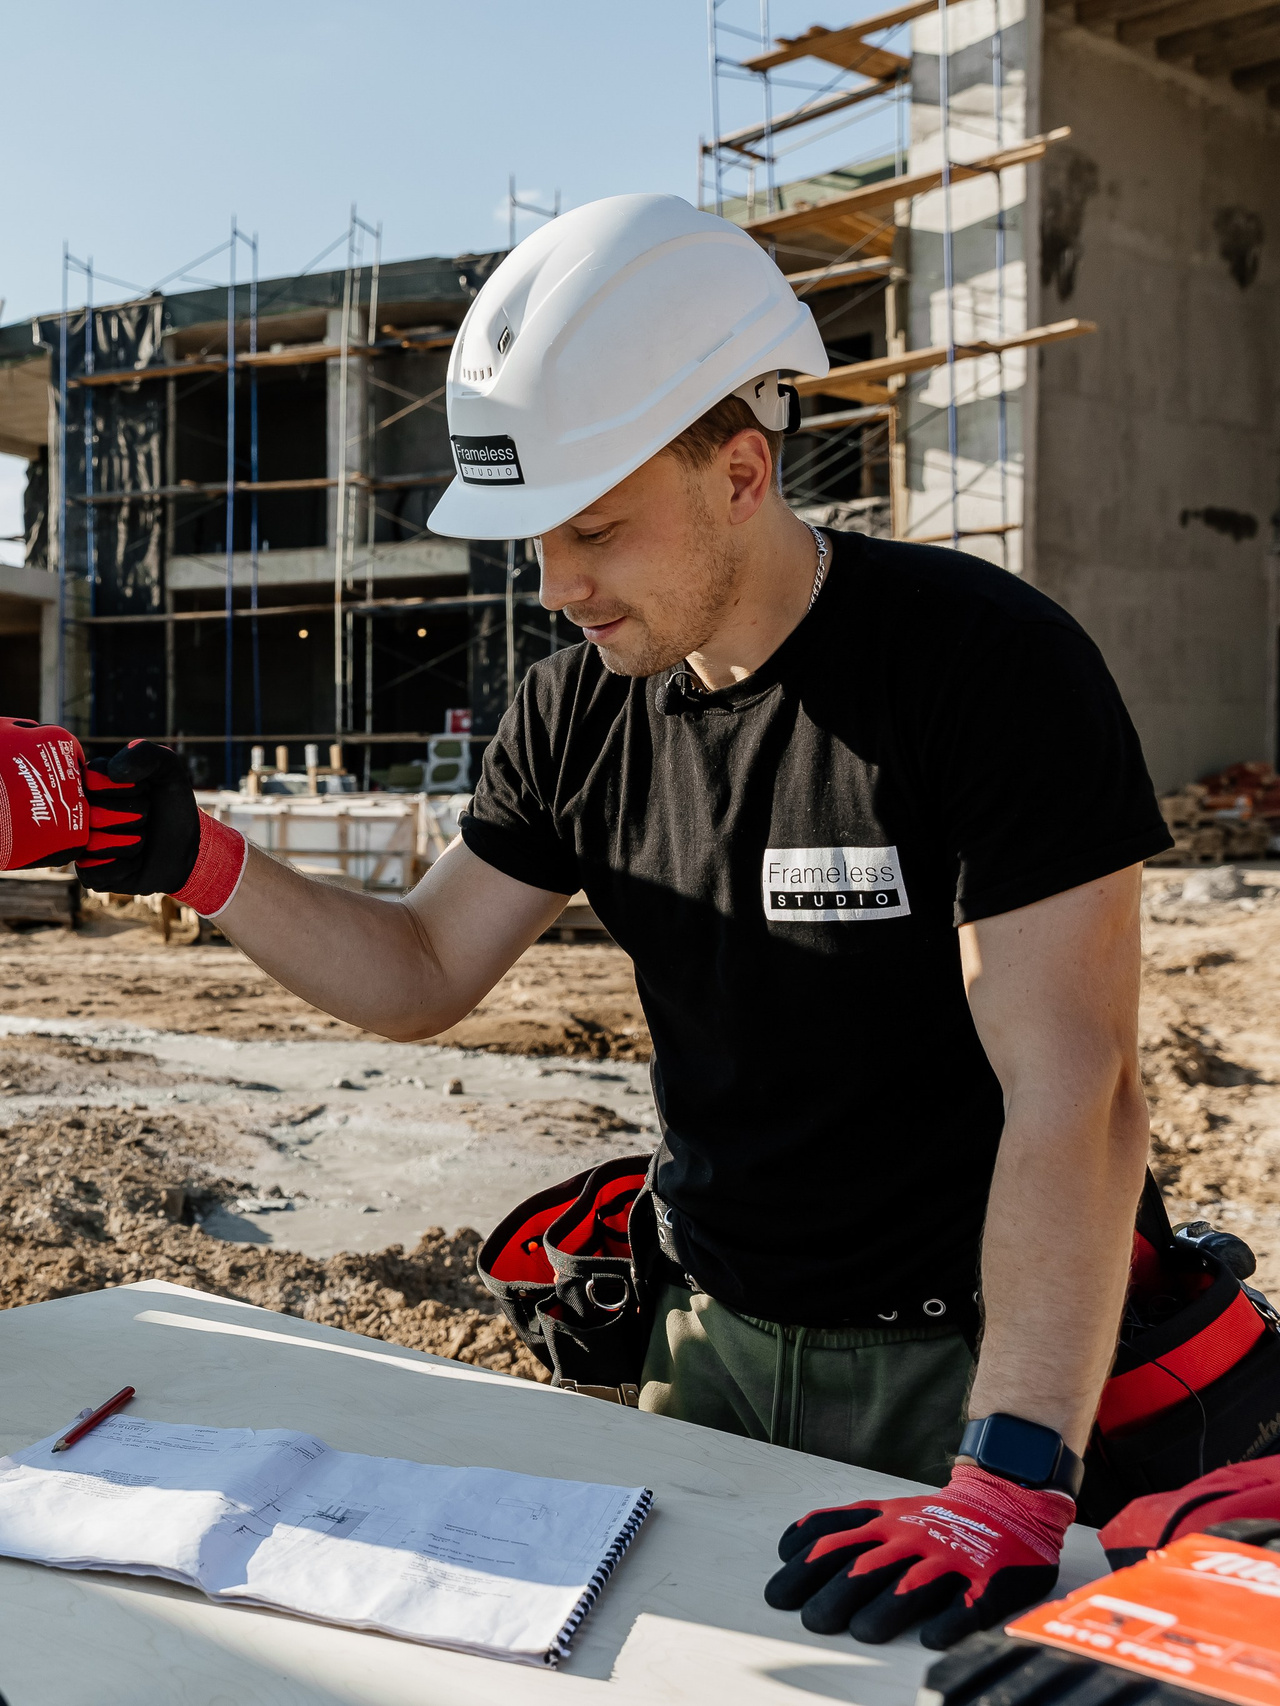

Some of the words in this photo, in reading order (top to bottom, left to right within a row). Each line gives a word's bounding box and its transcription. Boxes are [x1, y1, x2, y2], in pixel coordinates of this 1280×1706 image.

[456, 444, 515, 461] Frameless
[464, 467, 513, 477] STUDIO
[769, 861, 895, 884] Frameless
[778, 893, 889, 907] STUDIO
[922, 1505, 1000, 1537] Milwaukee
